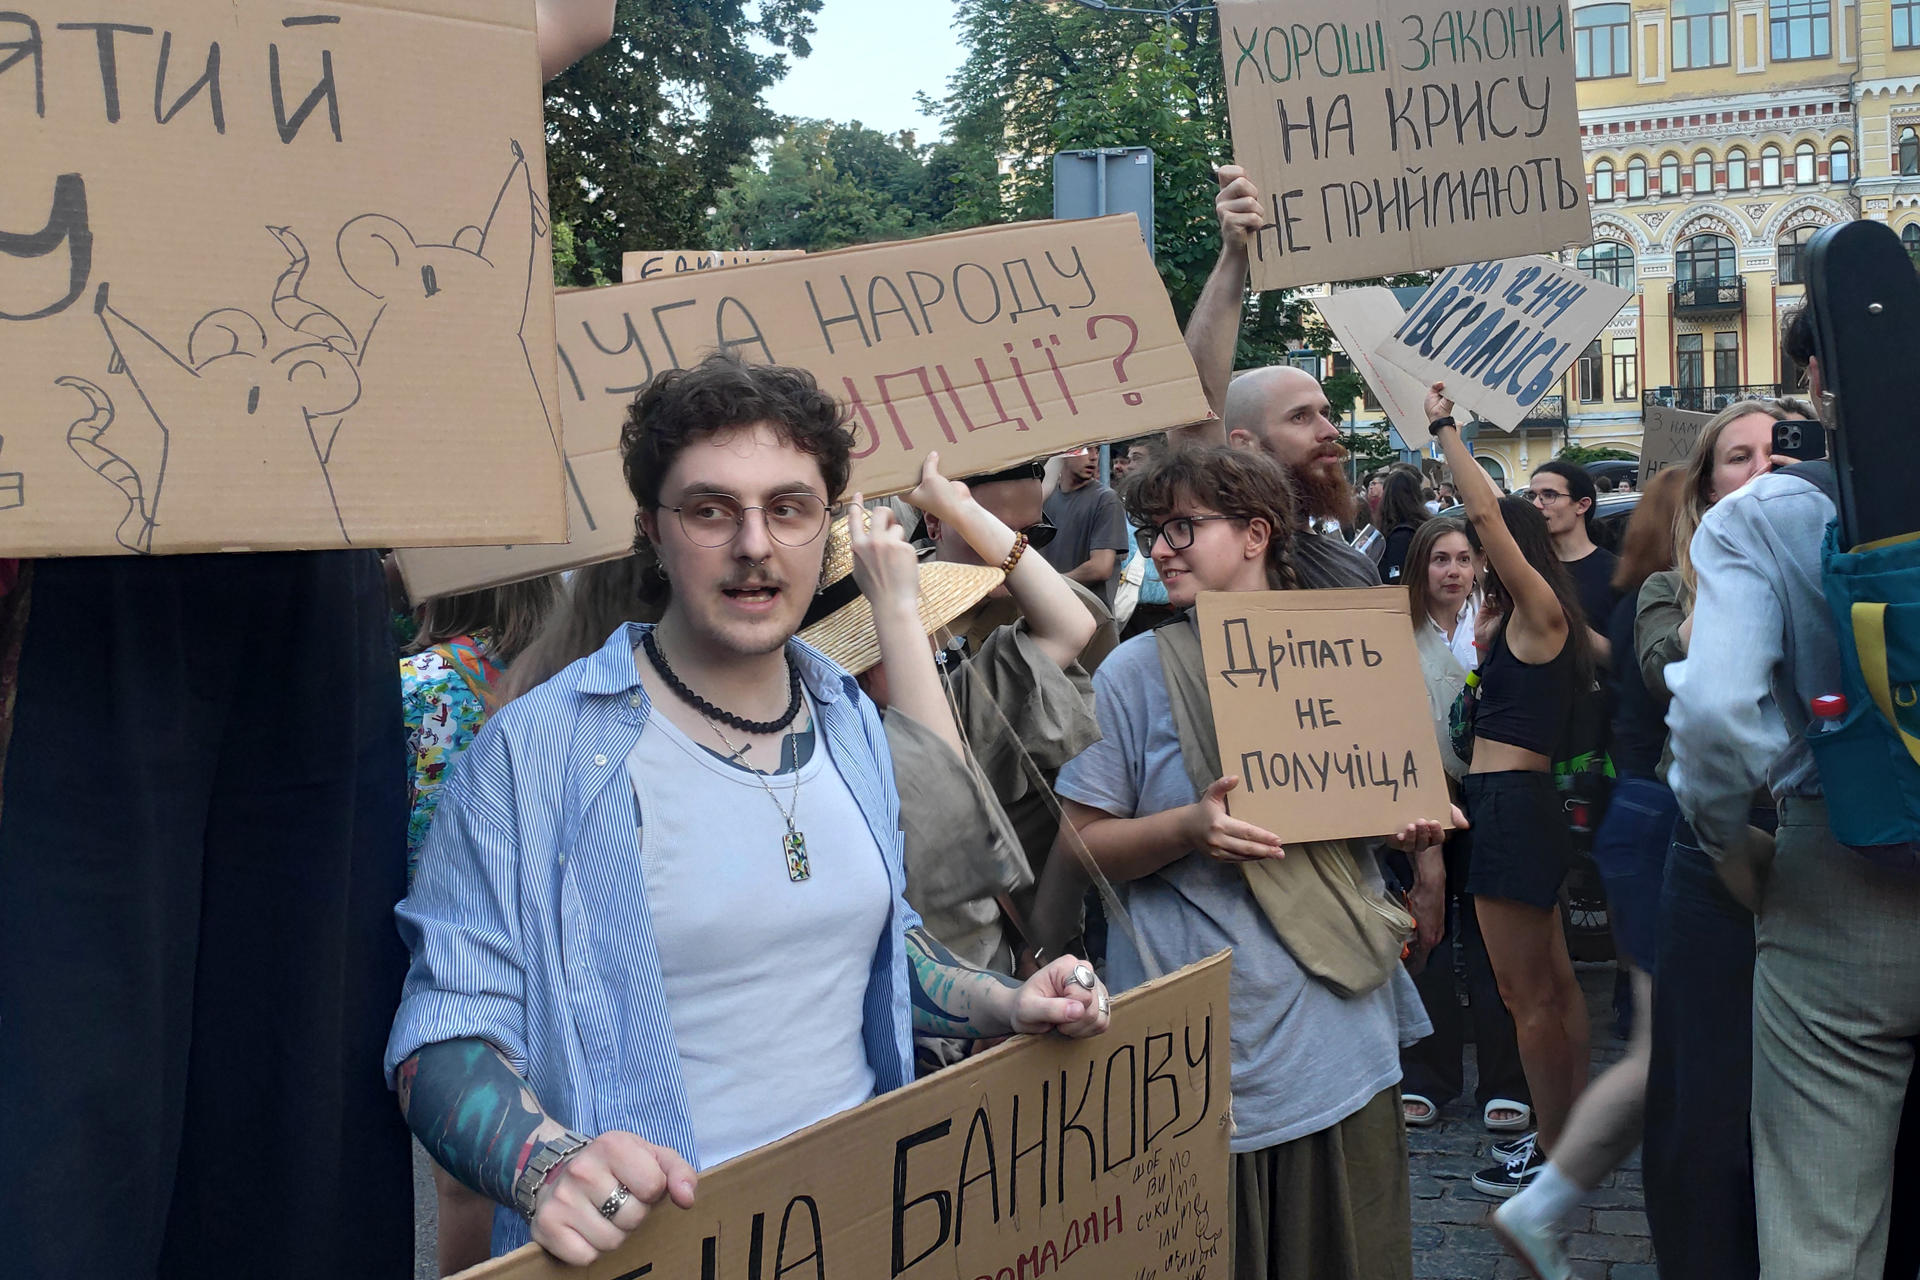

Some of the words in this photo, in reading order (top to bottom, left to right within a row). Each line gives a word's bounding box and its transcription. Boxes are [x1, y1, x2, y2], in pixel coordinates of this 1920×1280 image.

[1233, 20, 1386, 86] ХОРОШІ
[1401, 5, 1565, 71] ЗАКОНИ
[1277, 94, 1354, 164] НА
[1386, 76, 1550, 151] КРИСУ
[1256, 189, 1311, 262] НЕ
[1321, 158, 1578, 243] ПРИЙМАЮТЬ
[805, 246, 1096, 354] НАРОДУ
[1295, 698, 1342, 730] НЕ
[891, 1015, 1210, 1280] БАНКОВУ
